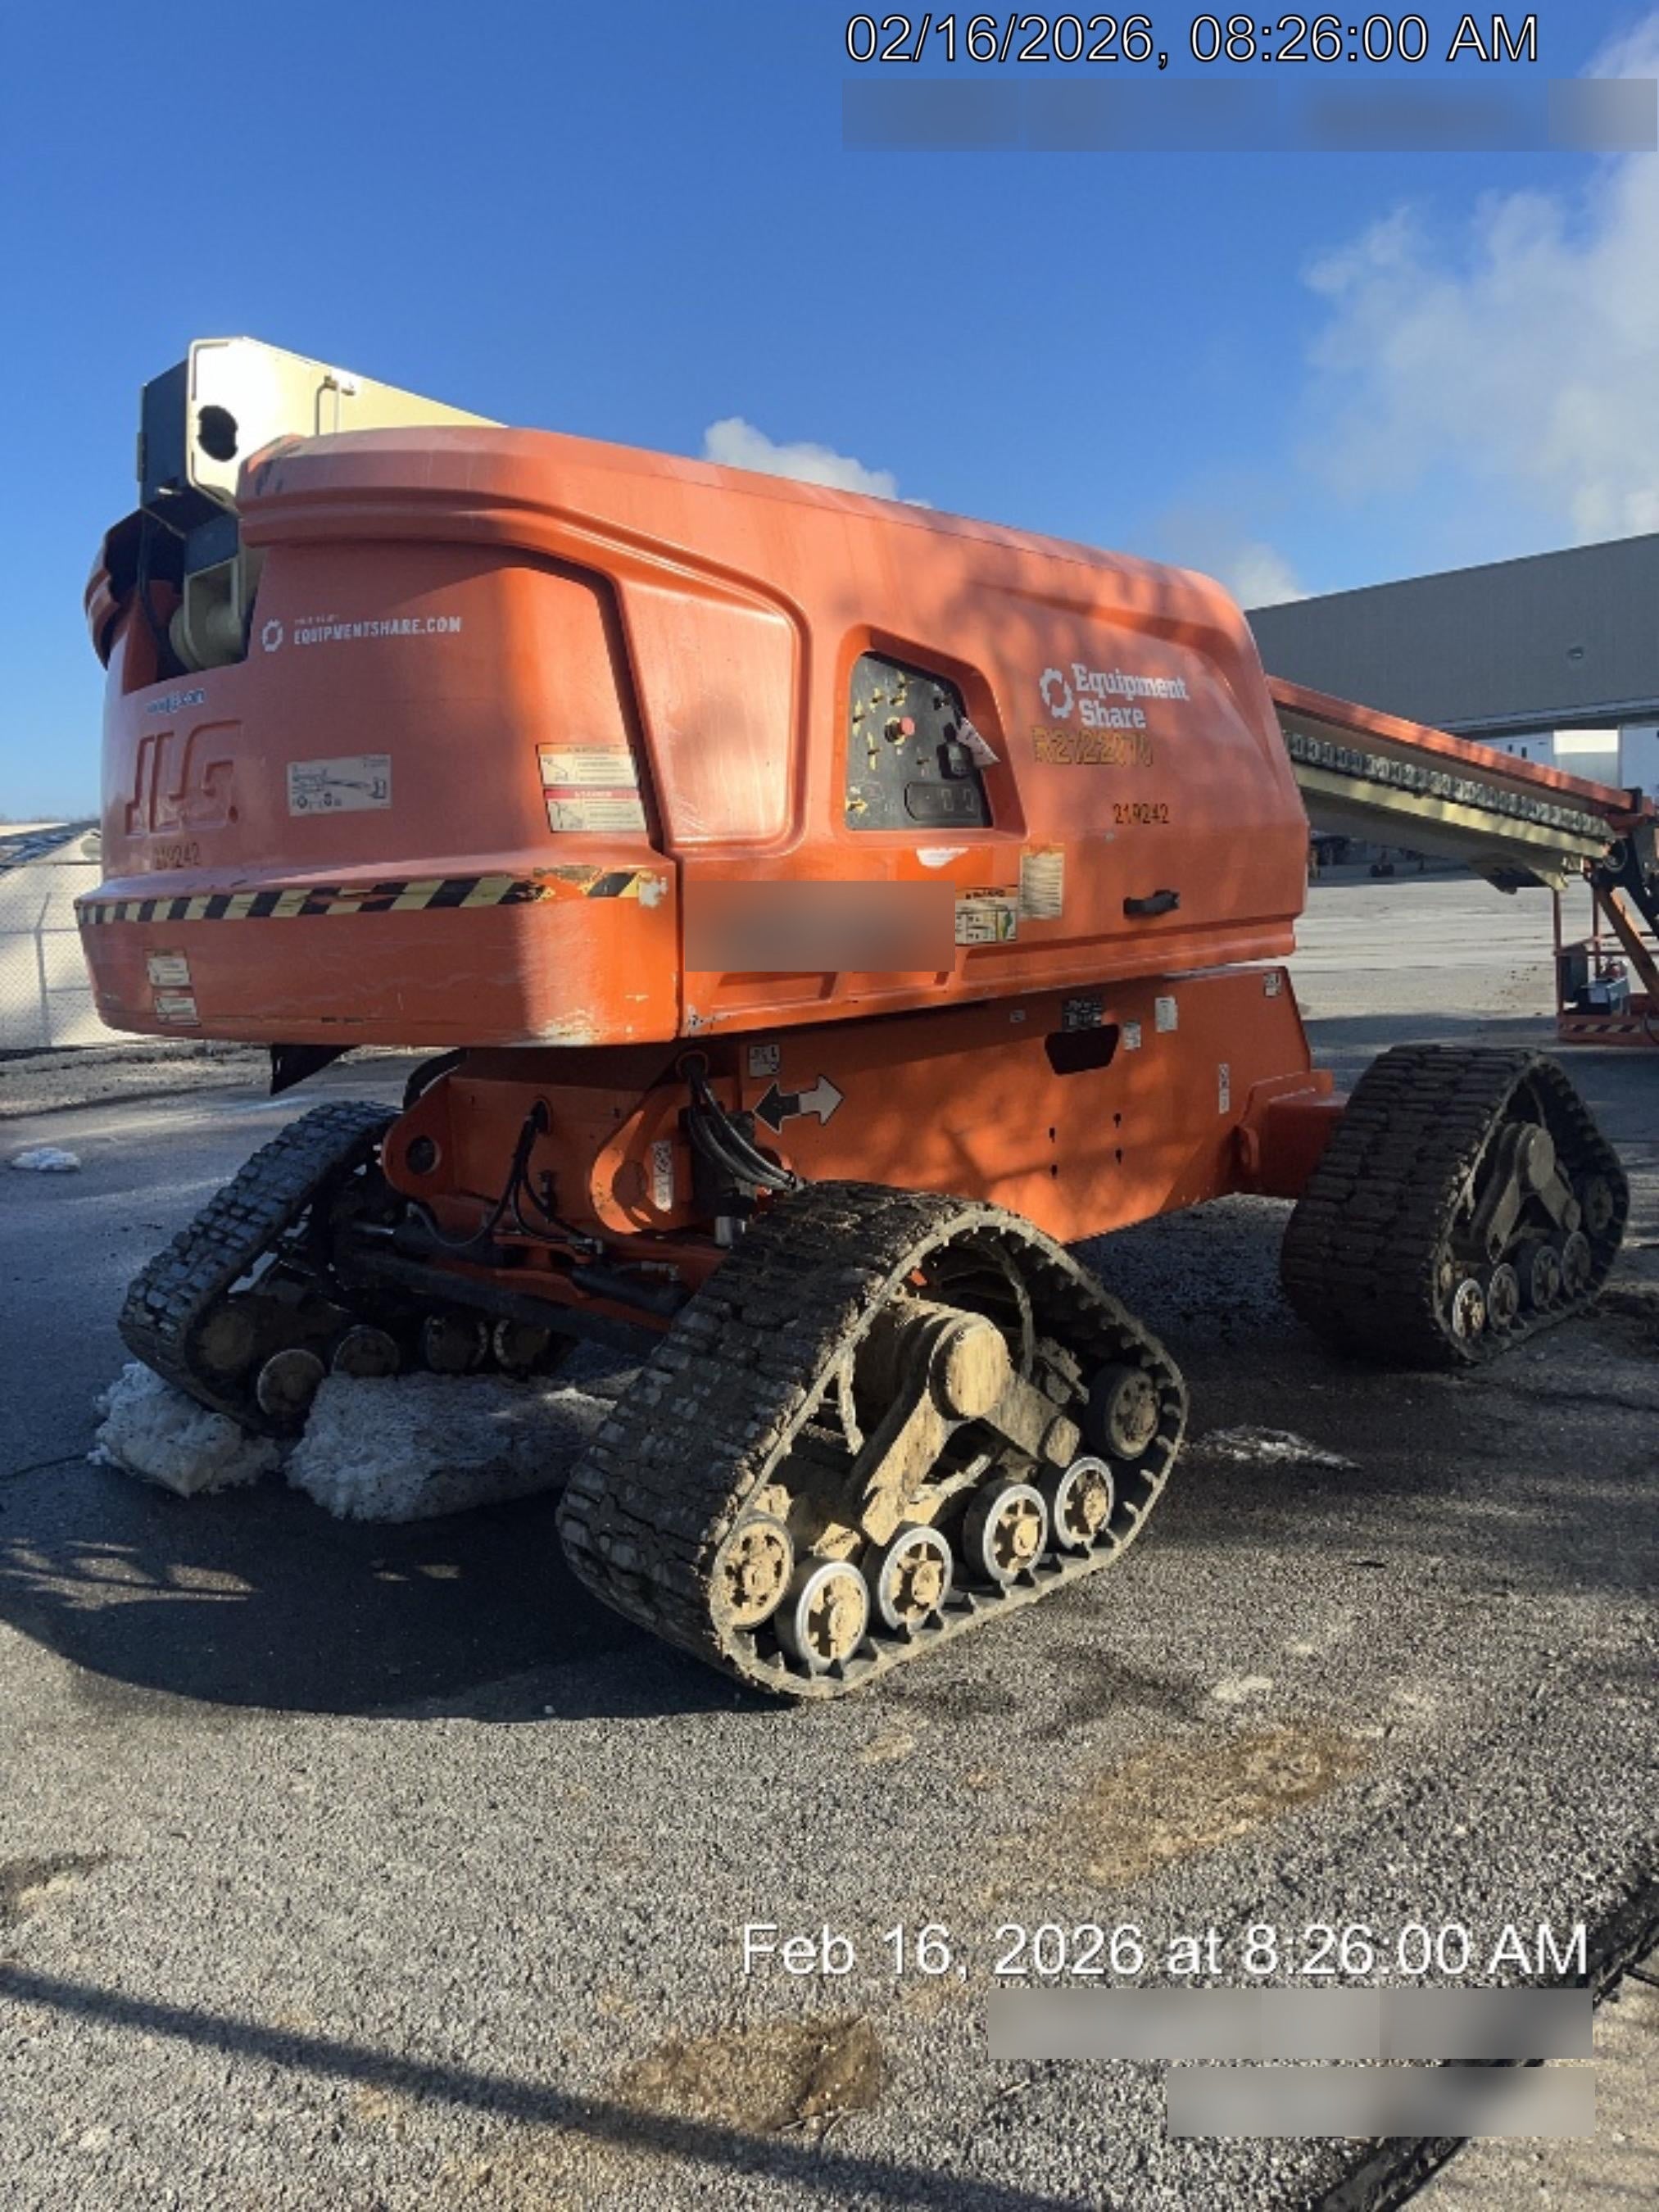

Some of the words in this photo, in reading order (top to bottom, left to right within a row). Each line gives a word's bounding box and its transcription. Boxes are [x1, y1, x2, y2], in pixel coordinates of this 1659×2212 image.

[293, 617, 461, 646] EQUIPMENTSHARE.COM
[1072, 663, 1190, 701] Equipment
[1078, 699, 1146, 728] Share
